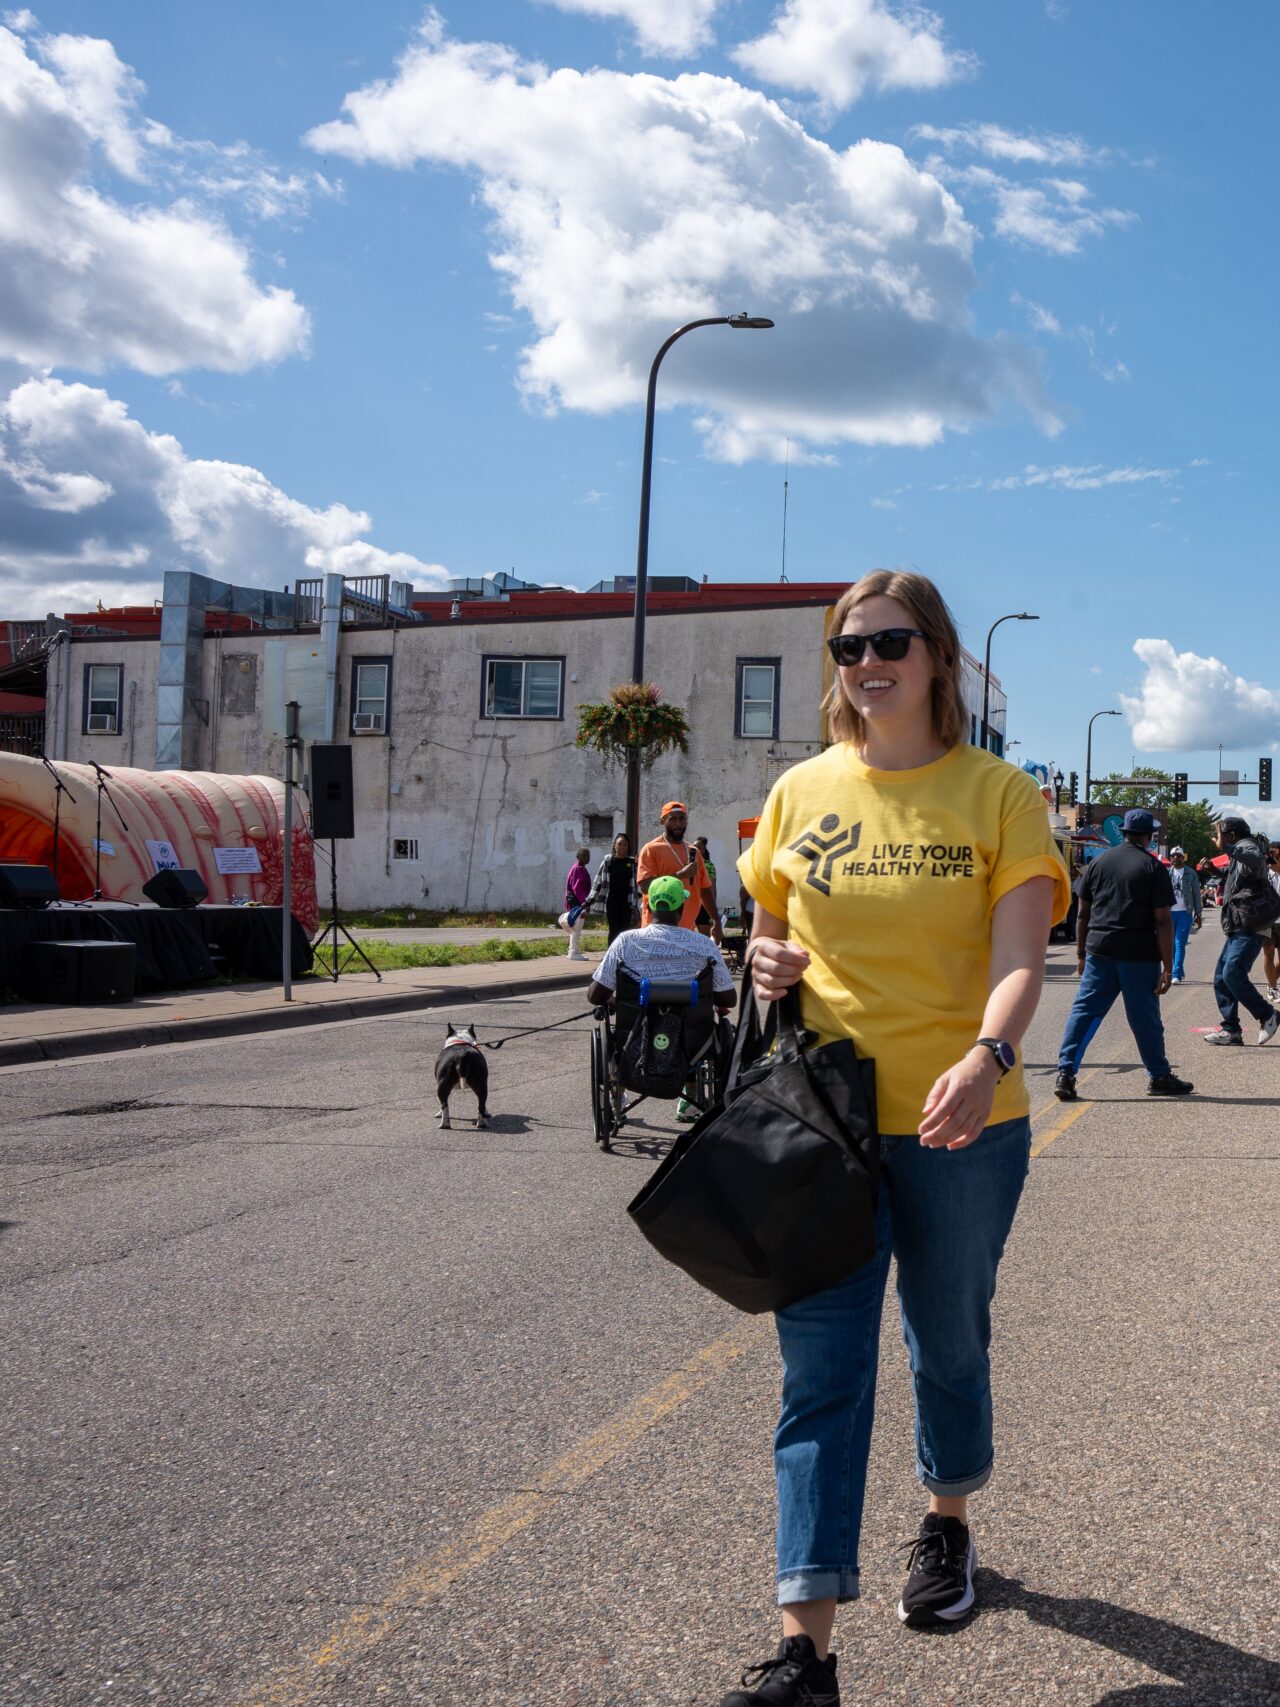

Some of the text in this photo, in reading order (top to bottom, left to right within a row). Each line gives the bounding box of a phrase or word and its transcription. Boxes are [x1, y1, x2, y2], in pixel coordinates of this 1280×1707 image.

[872, 843, 974, 862] LIVE YOUR
[842, 861, 974, 878] HEALTHY LYFE
